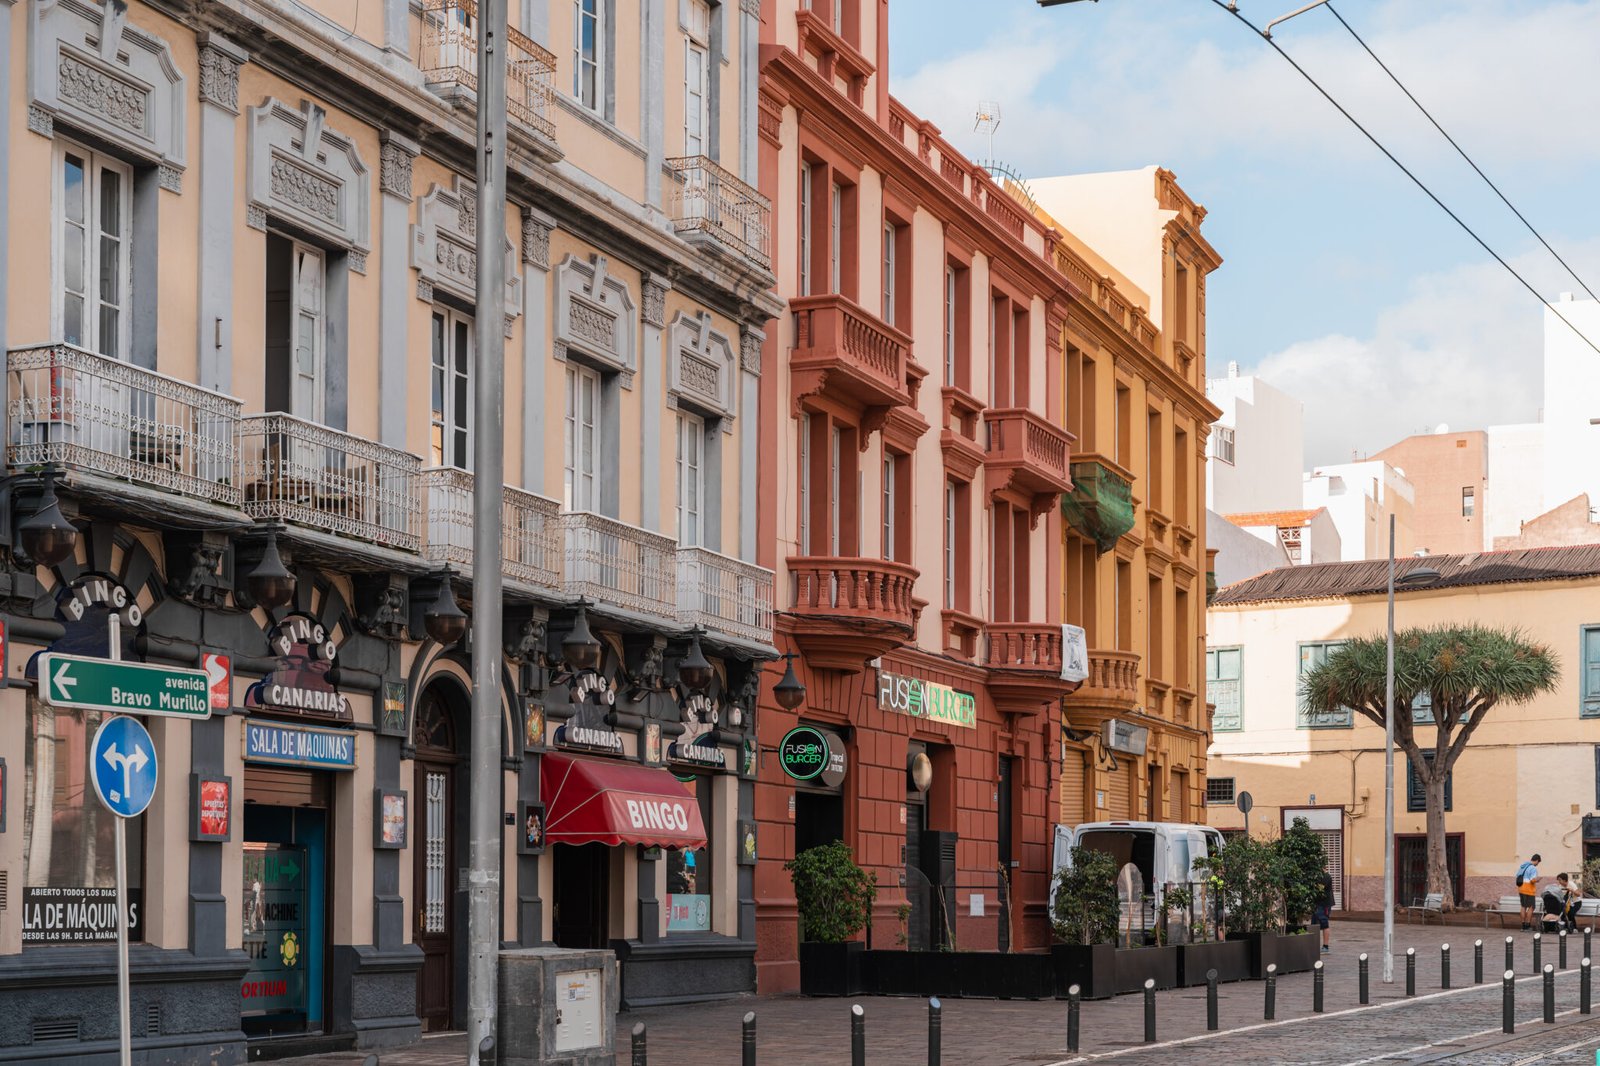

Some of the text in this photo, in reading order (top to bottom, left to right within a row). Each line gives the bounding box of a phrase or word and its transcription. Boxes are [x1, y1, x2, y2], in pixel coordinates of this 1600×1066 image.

[69, 580, 142, 627] BINGO
[280, 619, 336, 660] BINGO
[165, 677, 205, 691] avenida
[577, 673, 615, 705] BINGO
[881, 674, 930, 716] FUSION
[111, 687, 151, 707] Bravo
[159, 692, 206, 712] Murillo
[272, 685, 346, 713] CANARIAS
[687, 694, 719, 724] BINGO
[251, 728, 348, 761] SALA DE MAQUINAS
[572, 726, 622, 749] CANARIAS
[785, 743, 823, 755] FUSION
[683, 744, 724, 763] CANARIAS
[626, 800, 689, 832] BINGO
[31, 888, 118, 897] ABIERTO TODOS LOS DIAS
[21, 897, 138, 932] LA DE MÁQUINS
[22, 930, 119, 940] DESDE LAS 9H. DE LA MAÑAN
